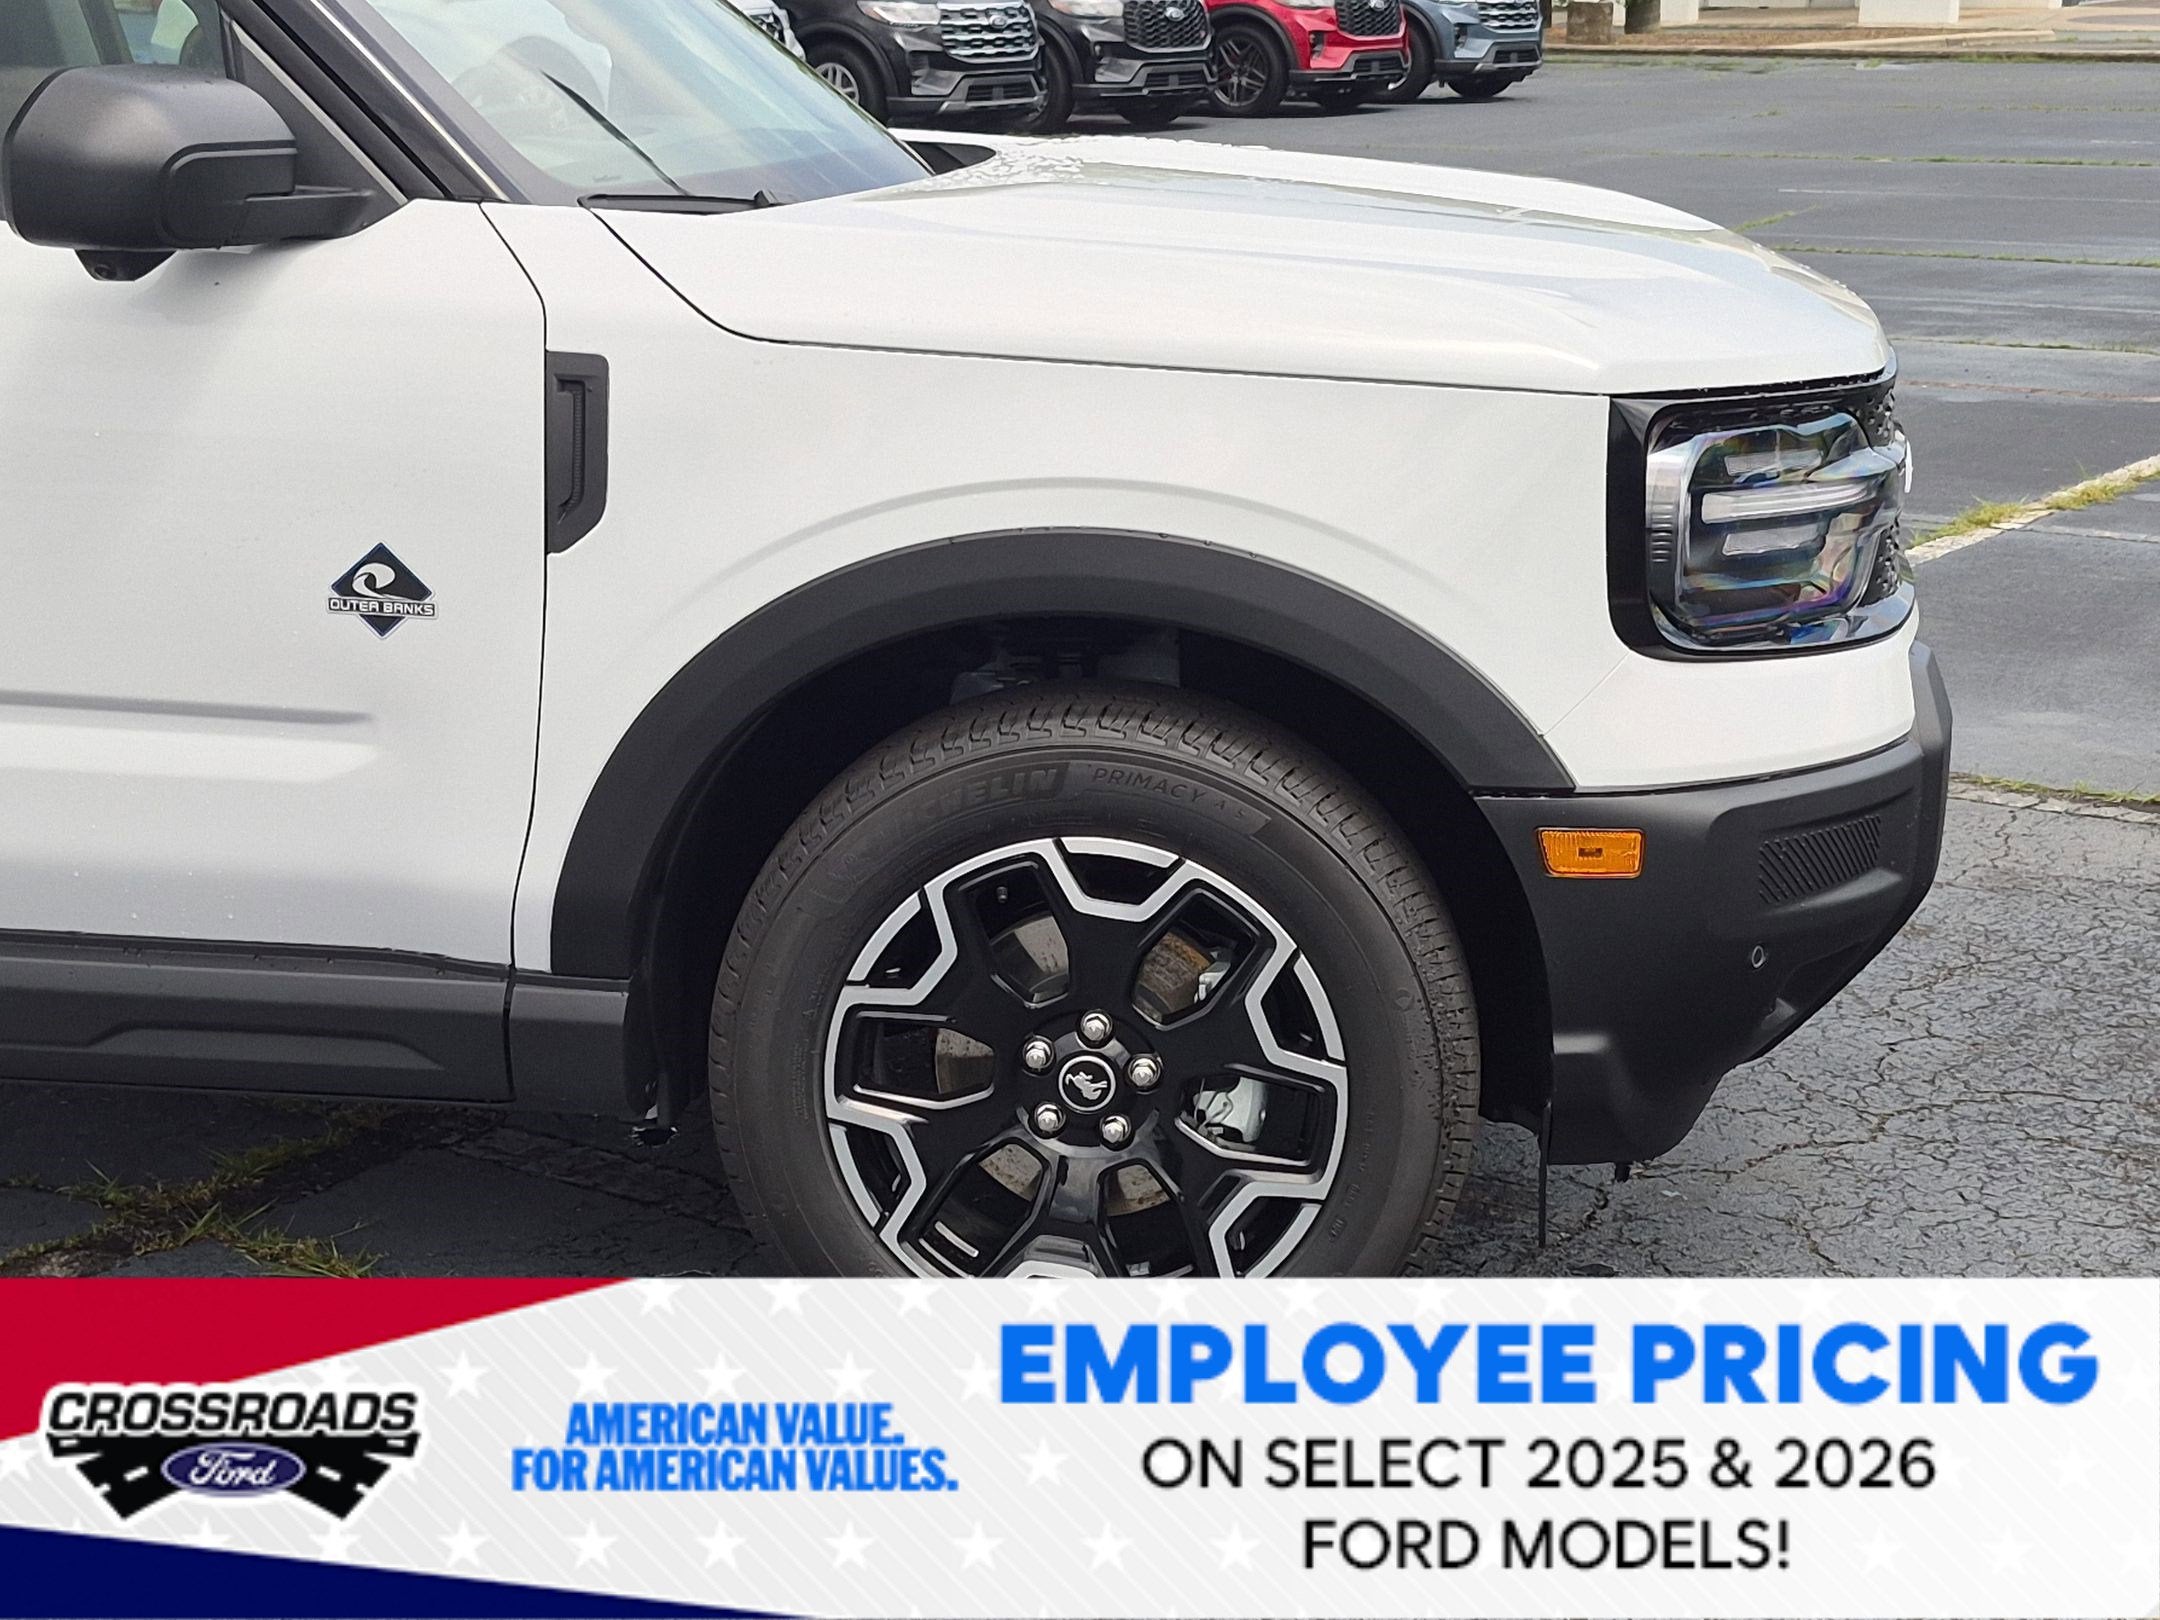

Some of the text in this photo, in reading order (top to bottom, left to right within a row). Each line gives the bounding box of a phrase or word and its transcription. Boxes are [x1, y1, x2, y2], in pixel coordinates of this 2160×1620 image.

[329, 598, 435, 616] OUTER BANKS
[1092, 767, 1206, 802] PRIMACY
